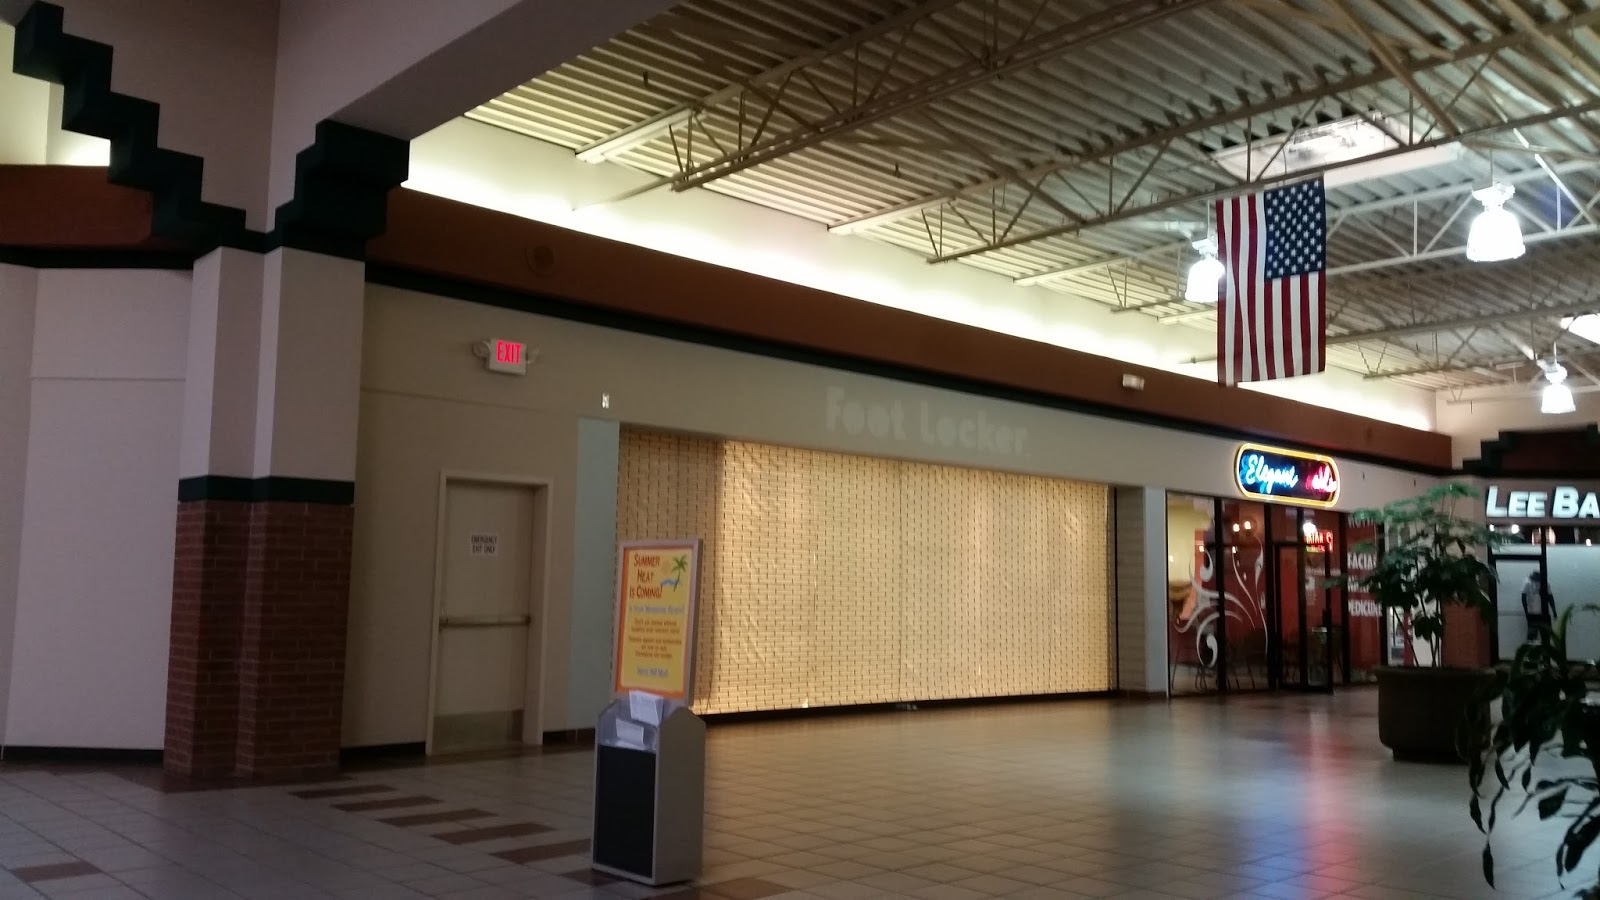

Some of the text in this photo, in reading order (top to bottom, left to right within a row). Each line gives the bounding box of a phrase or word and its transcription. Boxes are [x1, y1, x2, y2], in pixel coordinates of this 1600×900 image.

[496, 339, 522, 365] EXIT
[825, 385, 1028, 456] Foot Locker
[1243, 454, 1338, 495] Elegant ails
[1486, 485, 1548, 518] LEE
[634, 552, 660, 567] SUMMER
[637, 568, 655, 583] HEAT
